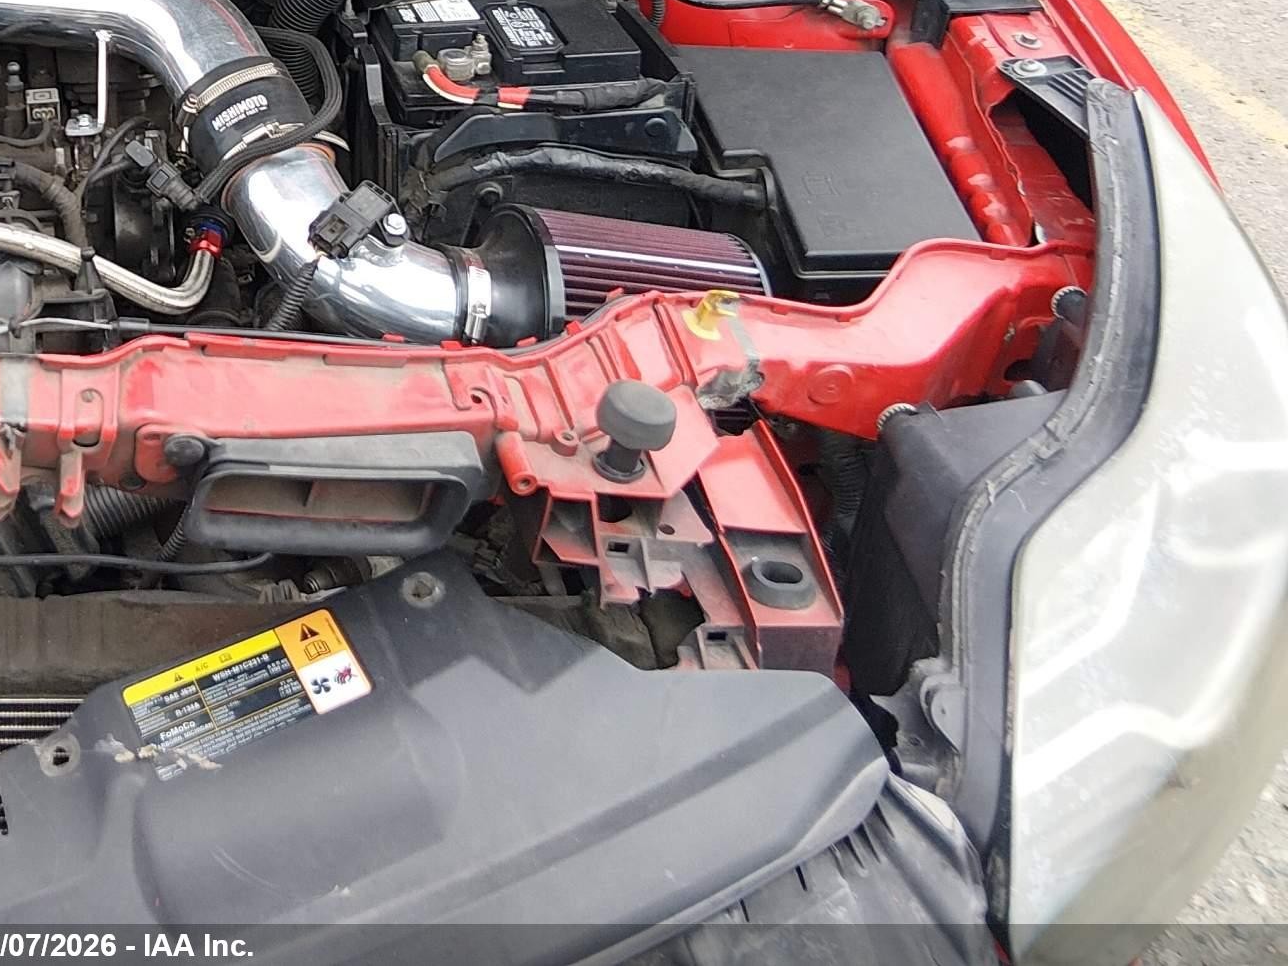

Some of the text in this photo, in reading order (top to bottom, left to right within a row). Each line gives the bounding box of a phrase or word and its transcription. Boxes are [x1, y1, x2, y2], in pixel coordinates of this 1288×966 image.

[212, 94, 268, 131] MISHIMOTO
[195, 662, 209, 672] A/C
[175, 701, 201, 717] R-134A
[160, 720, 196, 741] FoMoCo
